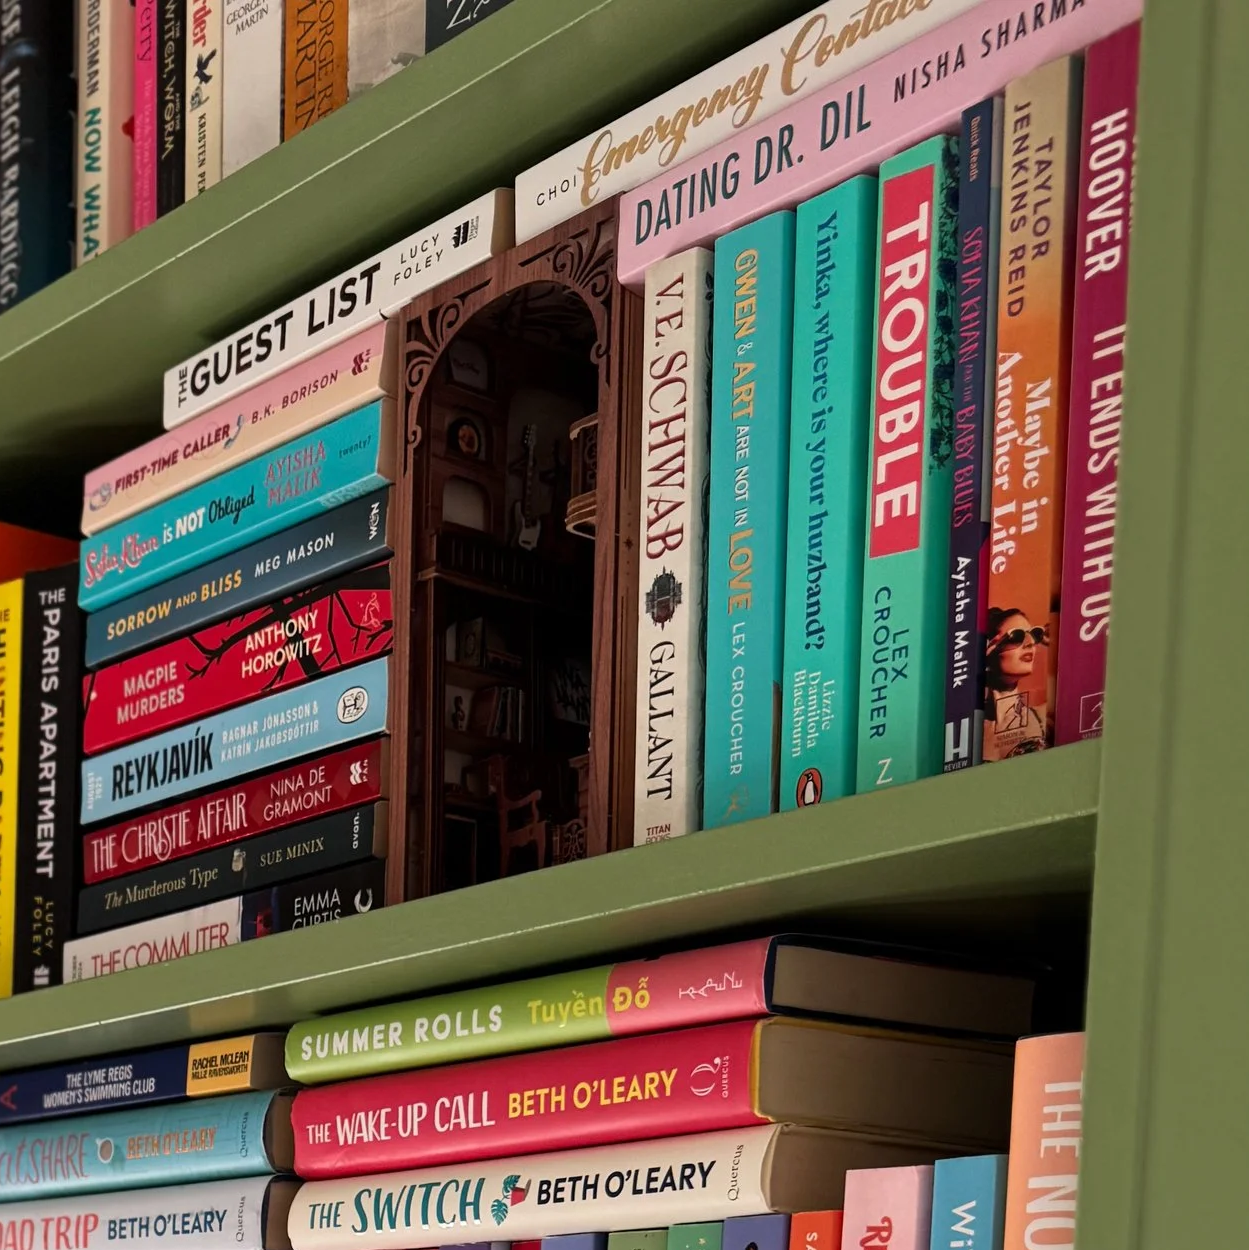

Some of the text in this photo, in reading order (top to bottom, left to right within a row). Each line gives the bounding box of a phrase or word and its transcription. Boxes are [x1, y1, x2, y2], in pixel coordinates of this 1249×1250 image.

[635, 161, 739, 246] DATING
[754, 135, 804, 186] DR.
[821, 85, 871, 150] DIL
[894, 44, 966, 103] NISHA
[83, 108, 101, 261] NOW WHA
[536, 175, 578, 205] CHOI
[1006, 101, 1032, 318] JENKINS REID
[1030, 137, 1054, 262] TAYLOR
[1084, 109, 1128, 282] HOOVER
[393, 249, 444, 286] FOLEY
[400, 233, 440, 265] LUCY
[178, 262, 381, 408] THE GUEST LIST
[874, 201, 929, 527] TROUBLE
[114, 452, 179, 495] FIRST-TIME
[183, 424, 230, 464] CALLER
[282, 369, 339, 409] BORISON
[646, 349, 687, 560] SCHWAB
[804, 210, 838, 652] Yinka, where is your huzband?
[989, 352, 1023, 577] Another Life
[1019, 378, 1053, 536] Maybe in
[727, 248, 758, 775] GWEN & ART ARE NOT IN LOVE LEX CROUCHER
[107, 532, 335, 641] SORROW AND BLISS MEG MASON
[241, 634, 322, 679] HOROWITZ
[244, 610, 319, 653] ANTHONY
[869, 586, 891, 739] CROUCHER
[891, 628, 909, 683] LEX
[116, 684, 185, 724] MURDERS
[124, 661, 178, 698] MAGPIE
[35, 588, 66, 878] THE PARIS APARTMENT
[646, 640, 674, 801] GALLANT
[111, 727, 213, 801] REYKJAVÍK
[270, 766, 325, 799] NINA DE
[91, 793, 248, 873] THE CHRISTIE AFFAIR
[263, 786, 332, 822] GRAMONT
[105, 837, 324, 910] The Murderous Type SUE MINIX
[301, 1017, 402, 1061] SUMMER
[414, 1005, 503, 1043] ROLLS
[527, 991, 603, 1028] Tuyền
[43, 1078, 156, 1109] WOMEN'S SWIMMING CLUB
[67, 1065, 133, 1088] THE LYME REGIS
[307, 1069, 678, 1147] THE WAKE-UP CALL BETH O'LEARY
[309, 1161, 716, 1236] THE SWITCH BETH O'LEARY
[728, 1144, 744, 1202] Quercus
[41, 1213, 99, 1250] TRIP
[108, 1218, 149, 1241] BETH
[153, 1210, 228, 1237] O'LEARY
